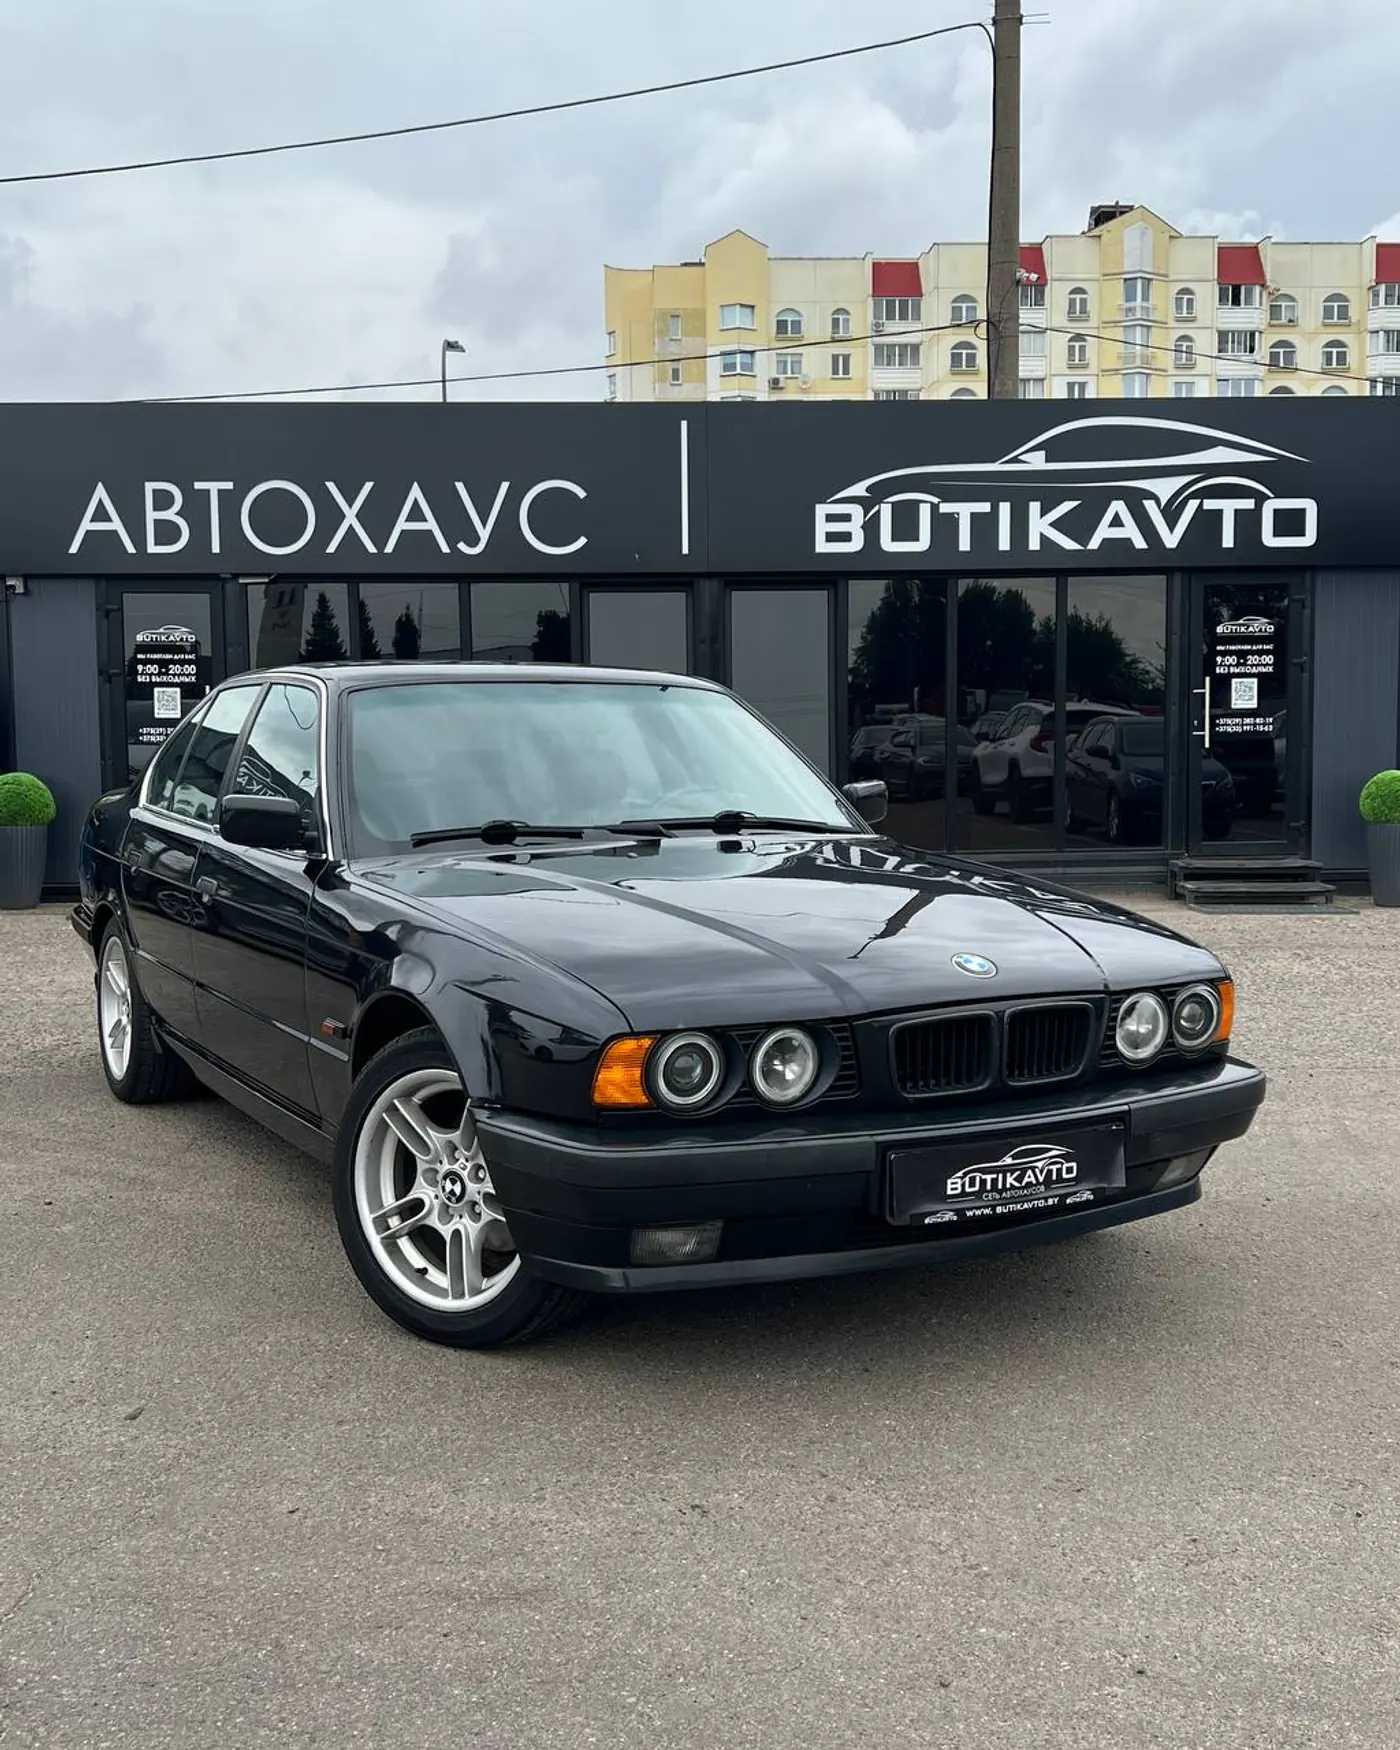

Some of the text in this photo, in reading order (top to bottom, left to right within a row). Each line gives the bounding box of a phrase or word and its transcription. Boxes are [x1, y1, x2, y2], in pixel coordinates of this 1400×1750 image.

[67, 479, 589, 556] АВТОХАУС
[814, 497, 1318, 554] BUTIKAVTO
[1216, 625, 1274, 633] BUTIKAVTO
[136, 634, 195, 642] BUTIKAVTO
[1215, 655, 1237, 666] 9:00
[1246, 654, 1274, 665] 20:00
[136, 664, 159, 674] 9:00
[168, 664, 197, 674] 20:00
[1229, 665, 1274, 674] ВЫХОДНЫХ
[151, 675, 197, 683] ВЫХОДНЫХ
[946, 1162, 1078, 1196] BUTIKAVTO
[982, 1185, 1046, 1201] СЕТЬ АВТОХАУСОВ
[995, 1196, 1060, 1214] BUTIKAVTO.BY
